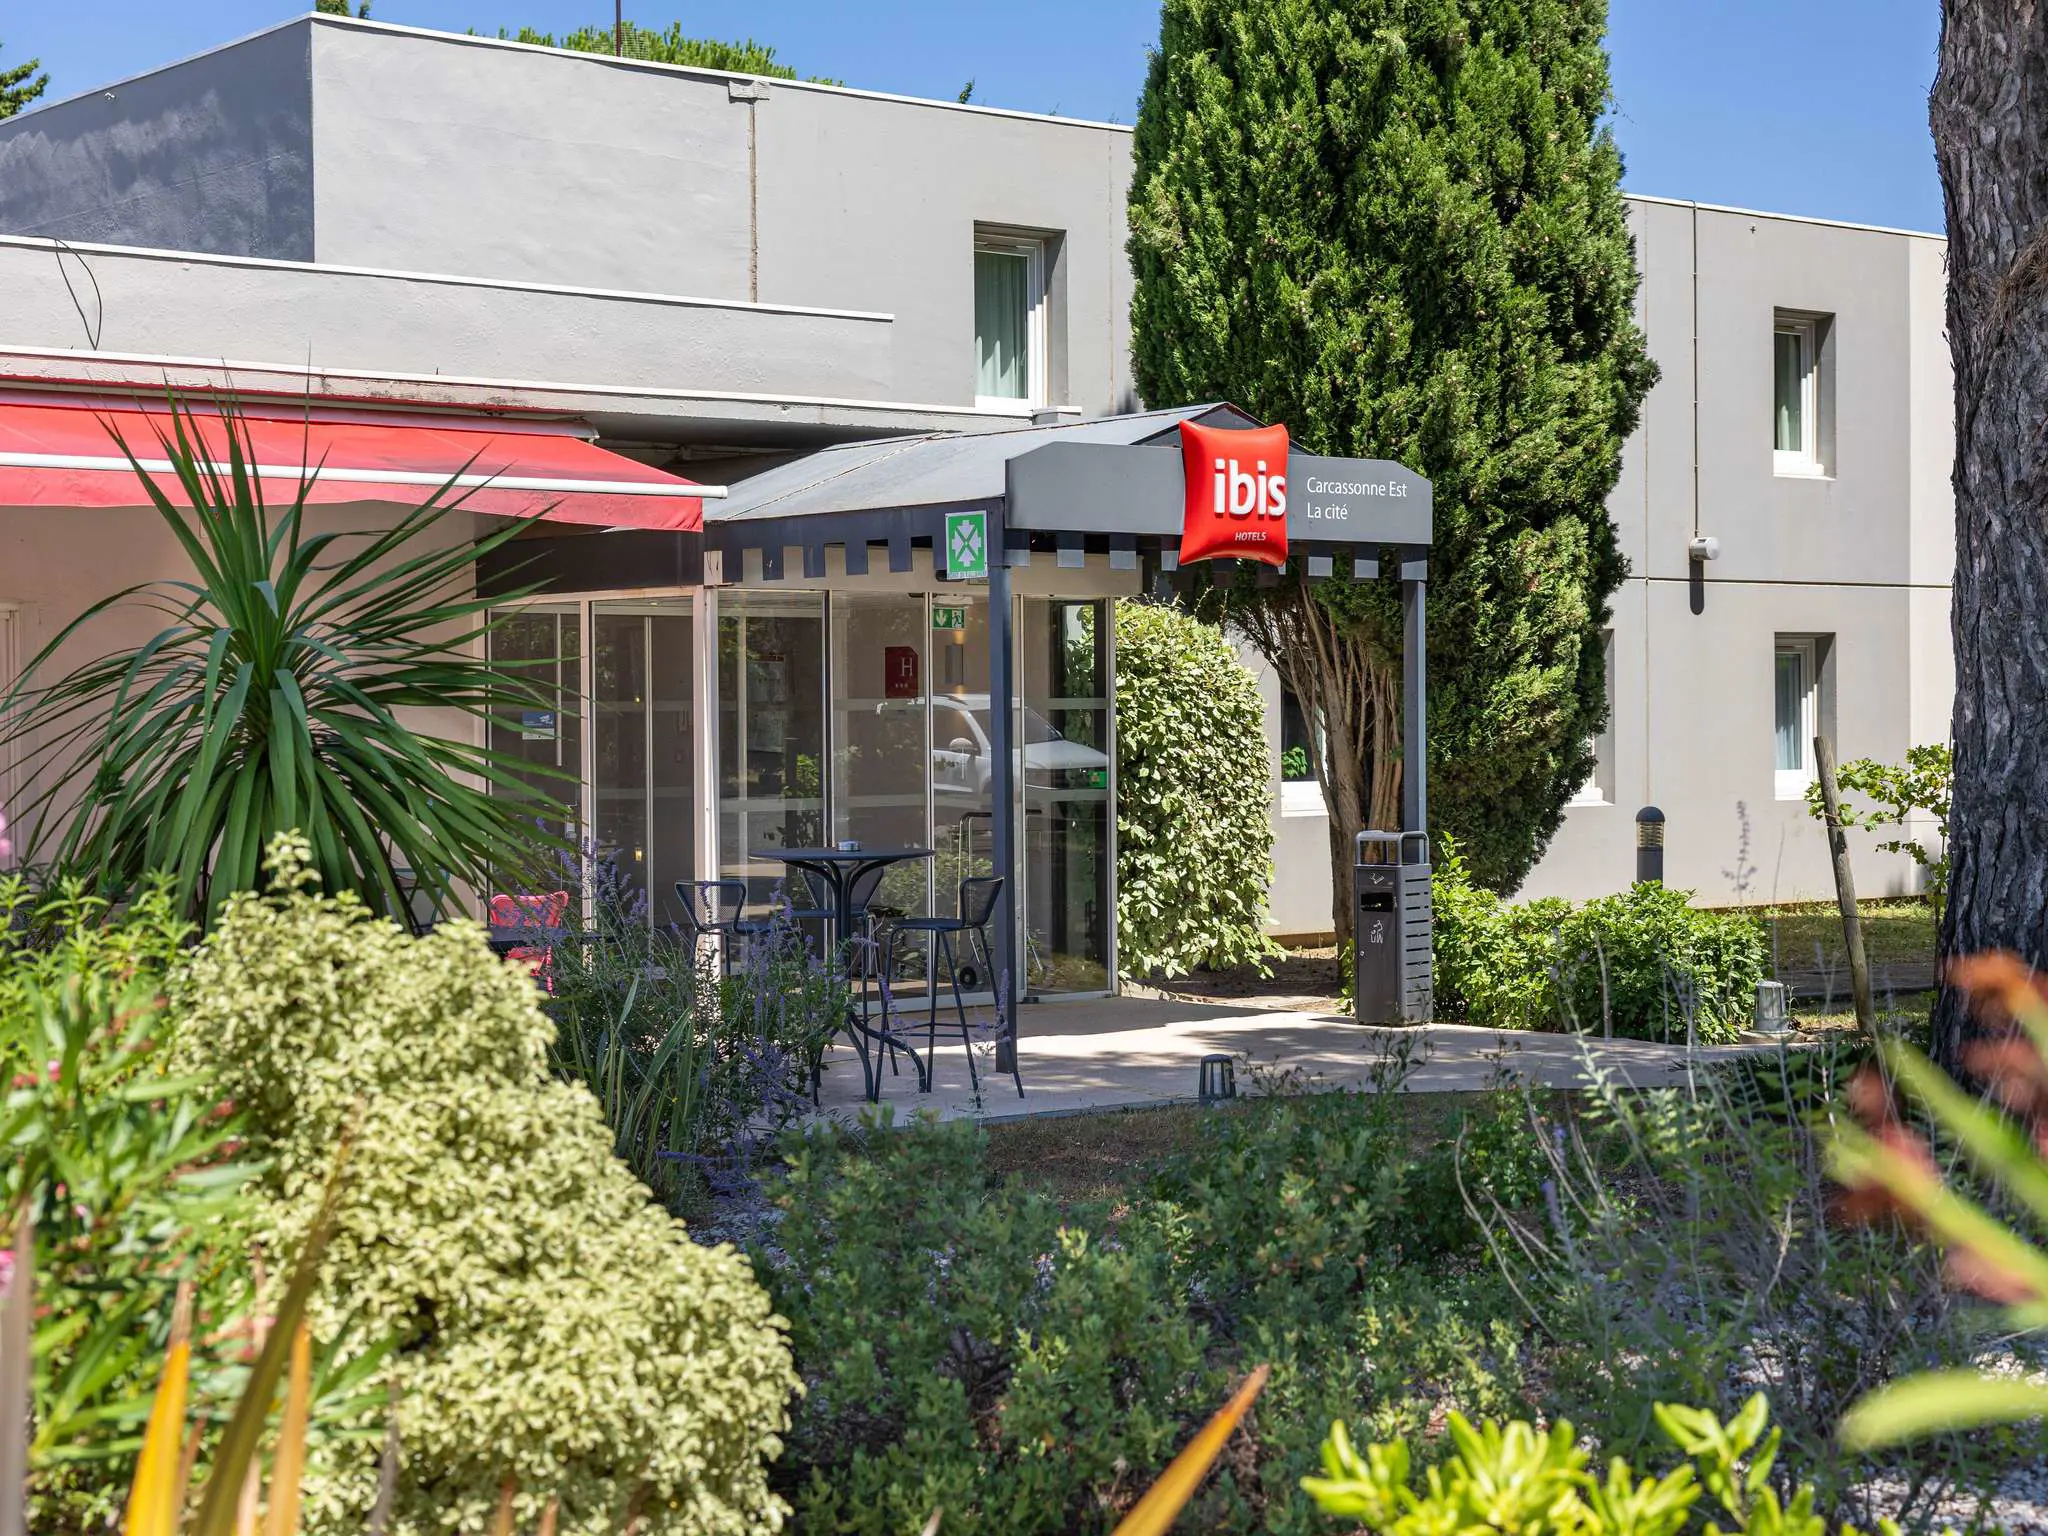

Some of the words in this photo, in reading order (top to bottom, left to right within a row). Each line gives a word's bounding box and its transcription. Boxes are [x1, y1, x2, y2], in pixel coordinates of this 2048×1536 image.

[1214, 458, 1286, 516] ibis
[1306, 477, 1386, 496] Carcassonne
[1389, 481, 1407, 497] Est
[1307, 502, 1321, 519] La
[1325, 504, 1348, 519] cité
[1235, 531, 1267, 541] HOTELS
[901, 657, 913, 677] H
